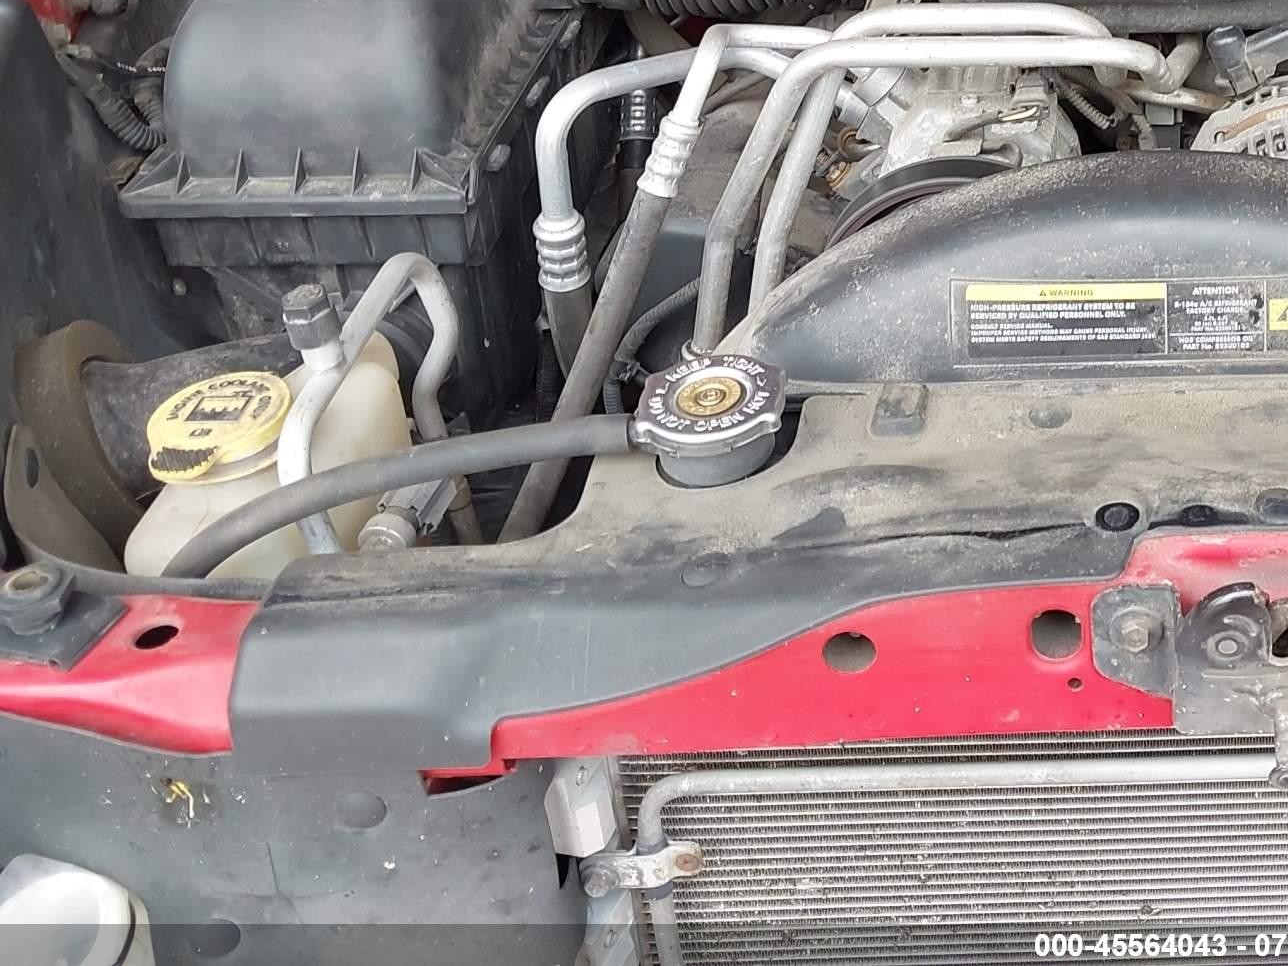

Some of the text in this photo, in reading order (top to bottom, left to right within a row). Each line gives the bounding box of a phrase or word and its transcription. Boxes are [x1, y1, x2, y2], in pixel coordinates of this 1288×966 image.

[1049, 289, 1094, 297] WARNING
[1191, 286, 1239, 295] ATTENTION
[1083, 302, 1113, 310] SYSTEM
[1114, 302, 1125, 310] TO
[1125, 301, 1136, 310] BE
[970, 312, 1007, 320] SERVICED
[1019, 311, 1059, 319] QUALIFIED
[1059, 310, 1104, 319] PERSONNEL
[1104, 310, 1126, 318] ONLY.
[665, 355, 765, 383] KEEP TIGHT
[208, 379, 272, 392] COOLANT
[694, 413, 745, 432] OPEN
[744, 390, 770, 414] HOT
